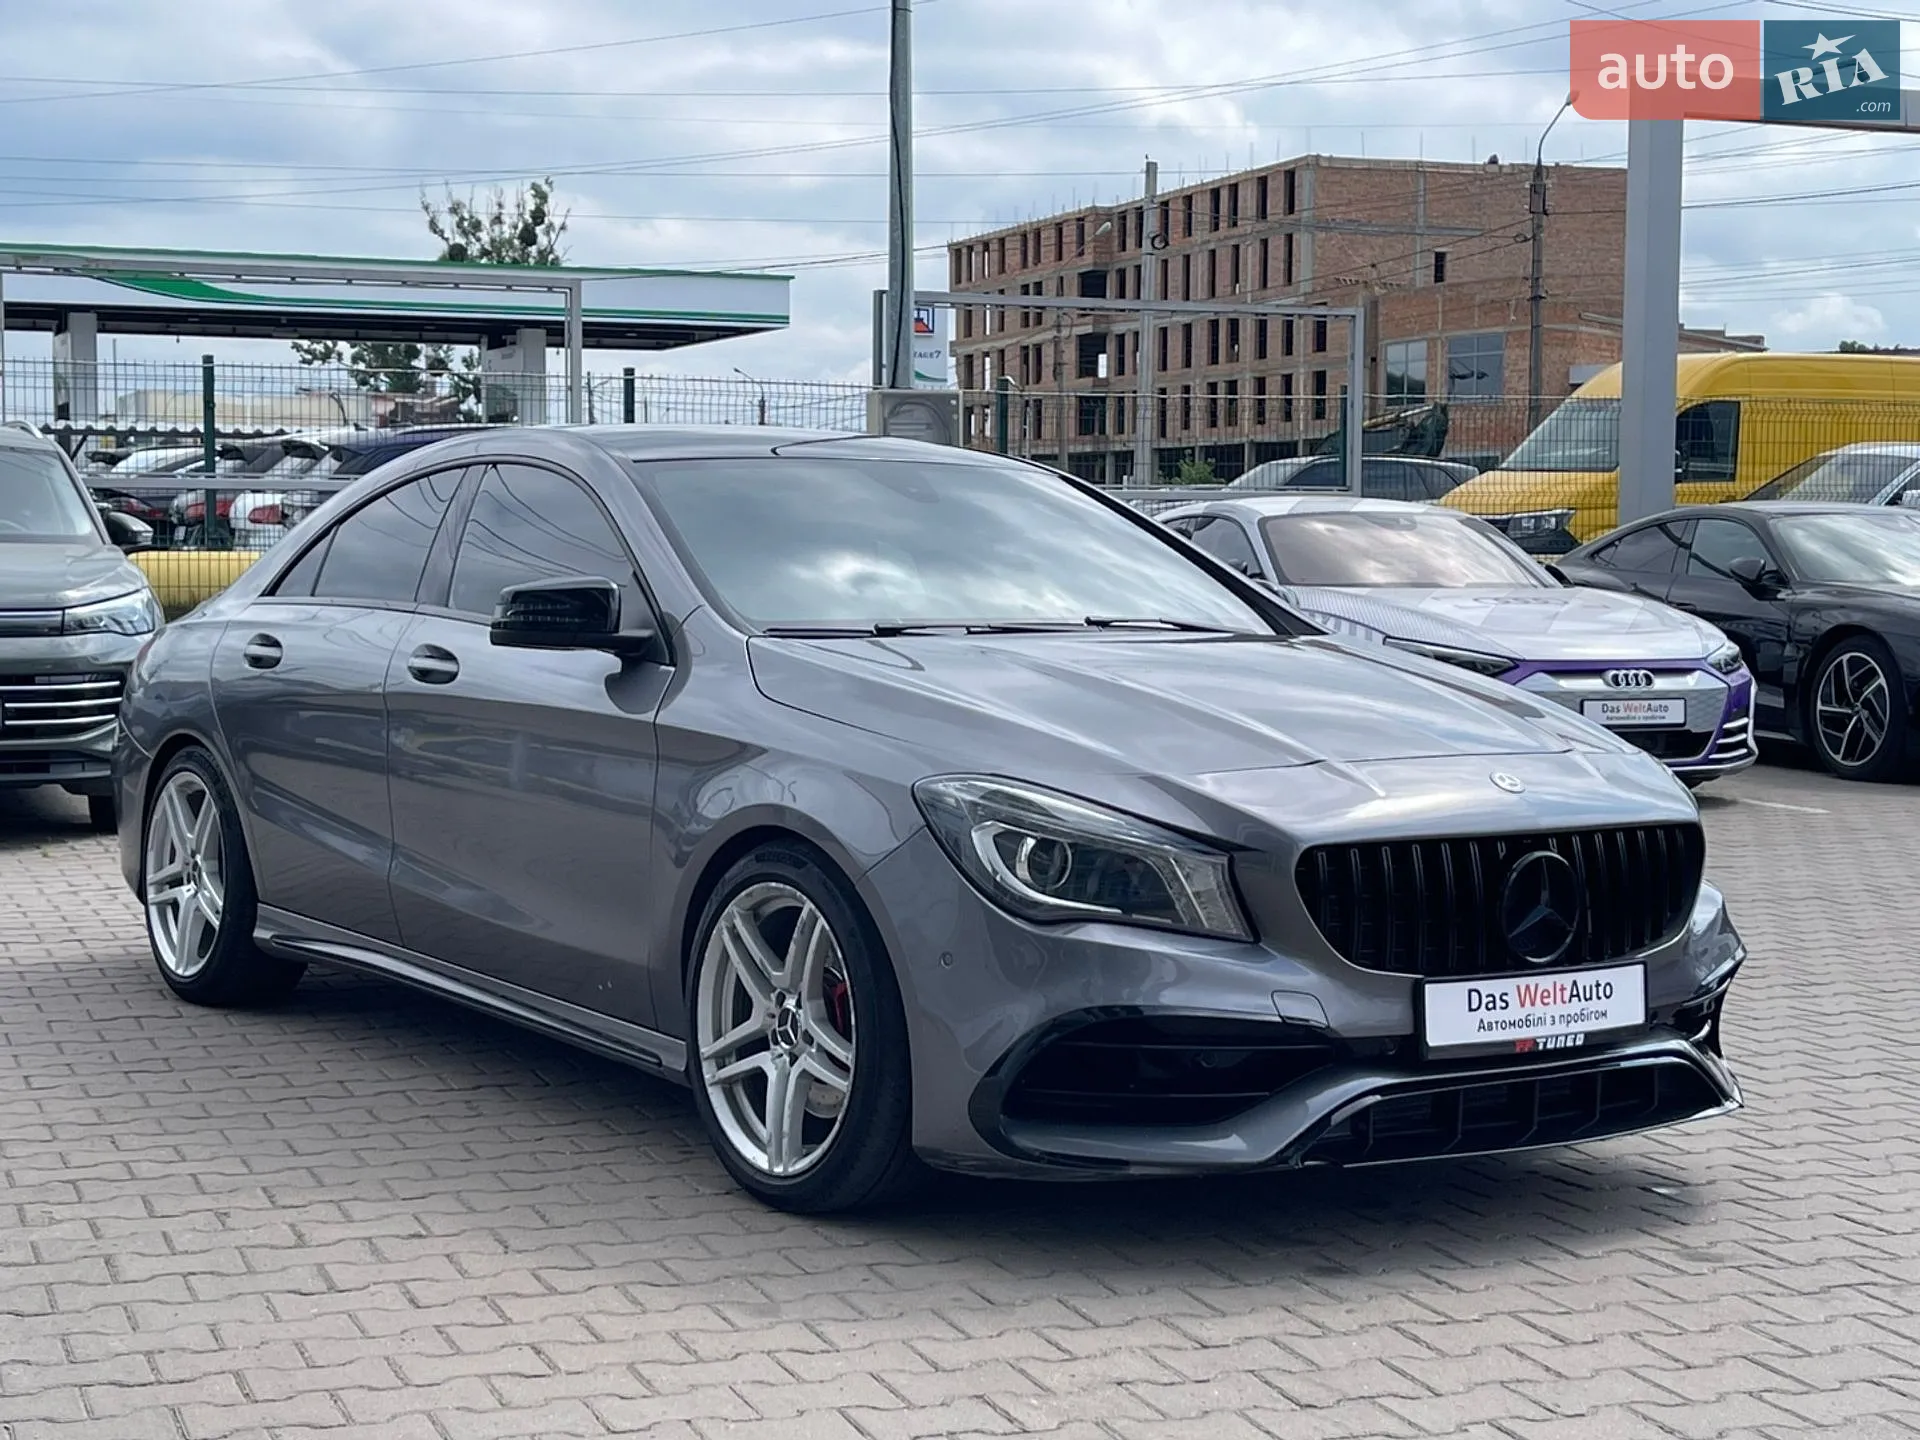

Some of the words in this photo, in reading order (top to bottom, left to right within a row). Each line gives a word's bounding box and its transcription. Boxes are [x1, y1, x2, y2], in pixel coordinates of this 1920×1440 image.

[1601, 703, 1621, 713] Das
[1623, 702, 1669, 713] WeltAuto
[1467, 987, 1510, 1012] Das
[1515, 980, 1614, 1009] WeltAuto
[1477, 1012, 1547, 1033] Автомобілі
[1550, 1016, 1556, 1026] з
[1559, 1008, 1608, 1028] пробігом
